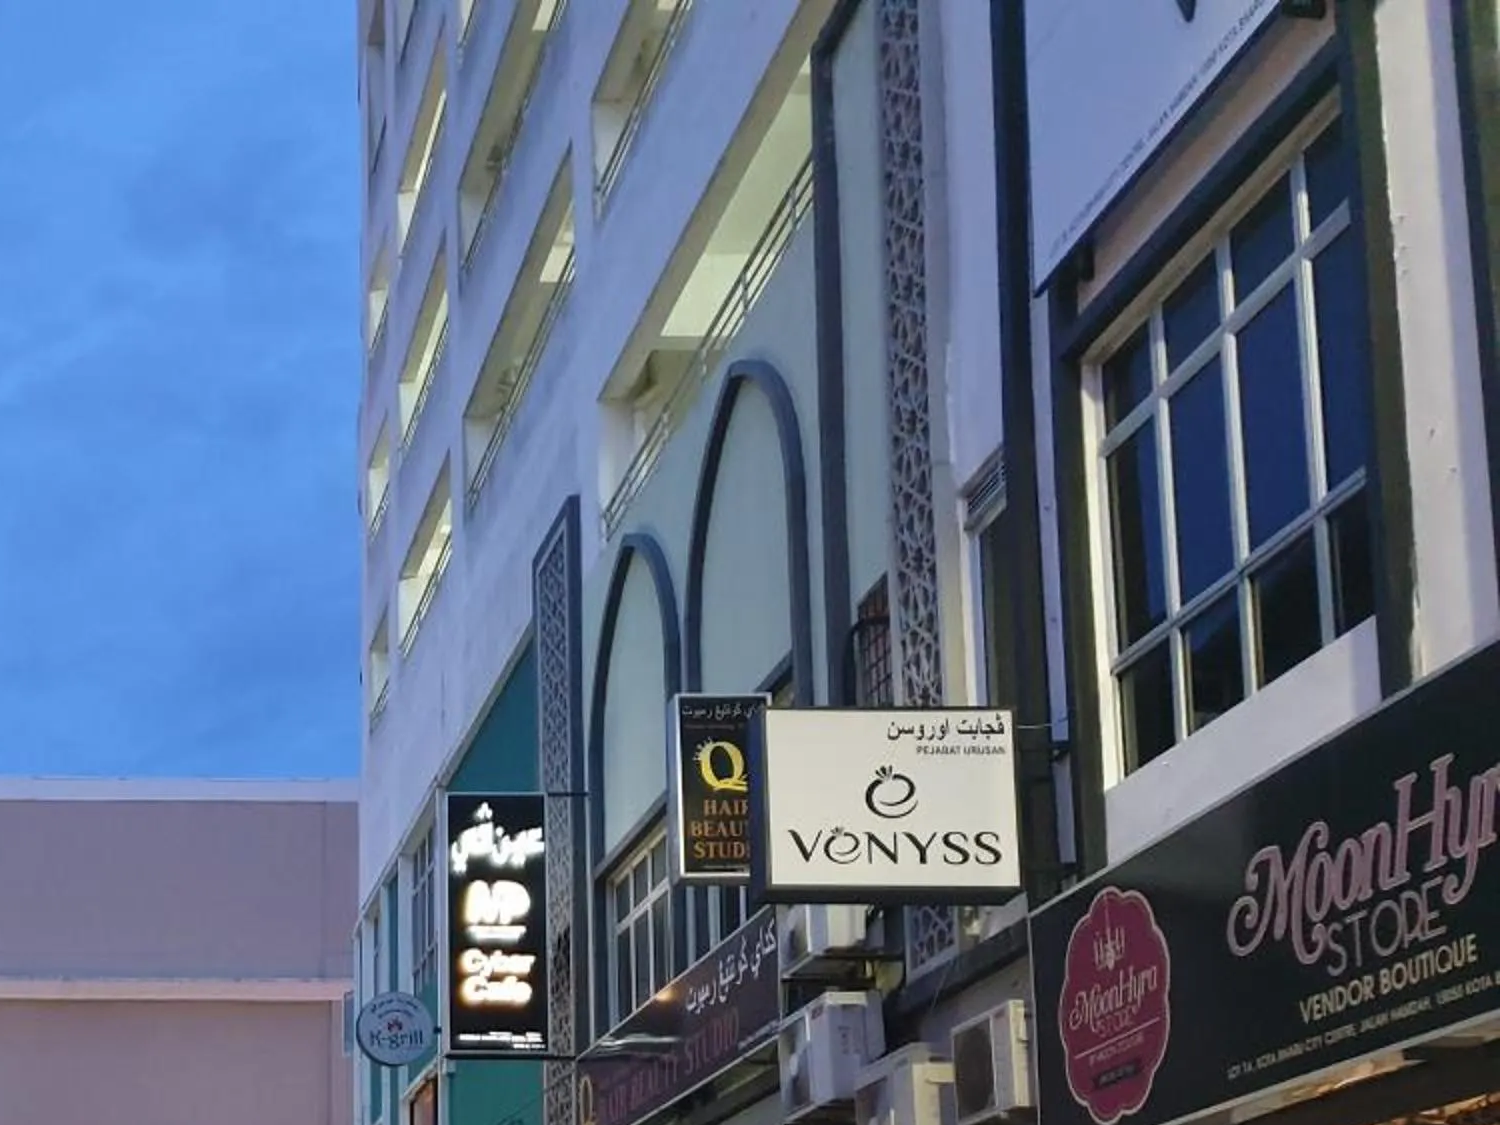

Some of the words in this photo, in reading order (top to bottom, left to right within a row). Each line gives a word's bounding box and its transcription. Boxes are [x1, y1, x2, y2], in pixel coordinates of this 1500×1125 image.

[916, 745, 960, 755] PEJABAT
[963, 745, 1005, 755] URUSAN
[691, 820, 749, 837] BEAU
[694, 841, 750, 859] STUD
[1226, 752, 1500, 965] MoonHyr
[1326, 875, 1448, 977] STORE
[462, 948, 536, 979] Cyber
[1300, 975, 1376, 1025] VENDOR
[1379, 933, 1477, 996] BOUTIQUE
